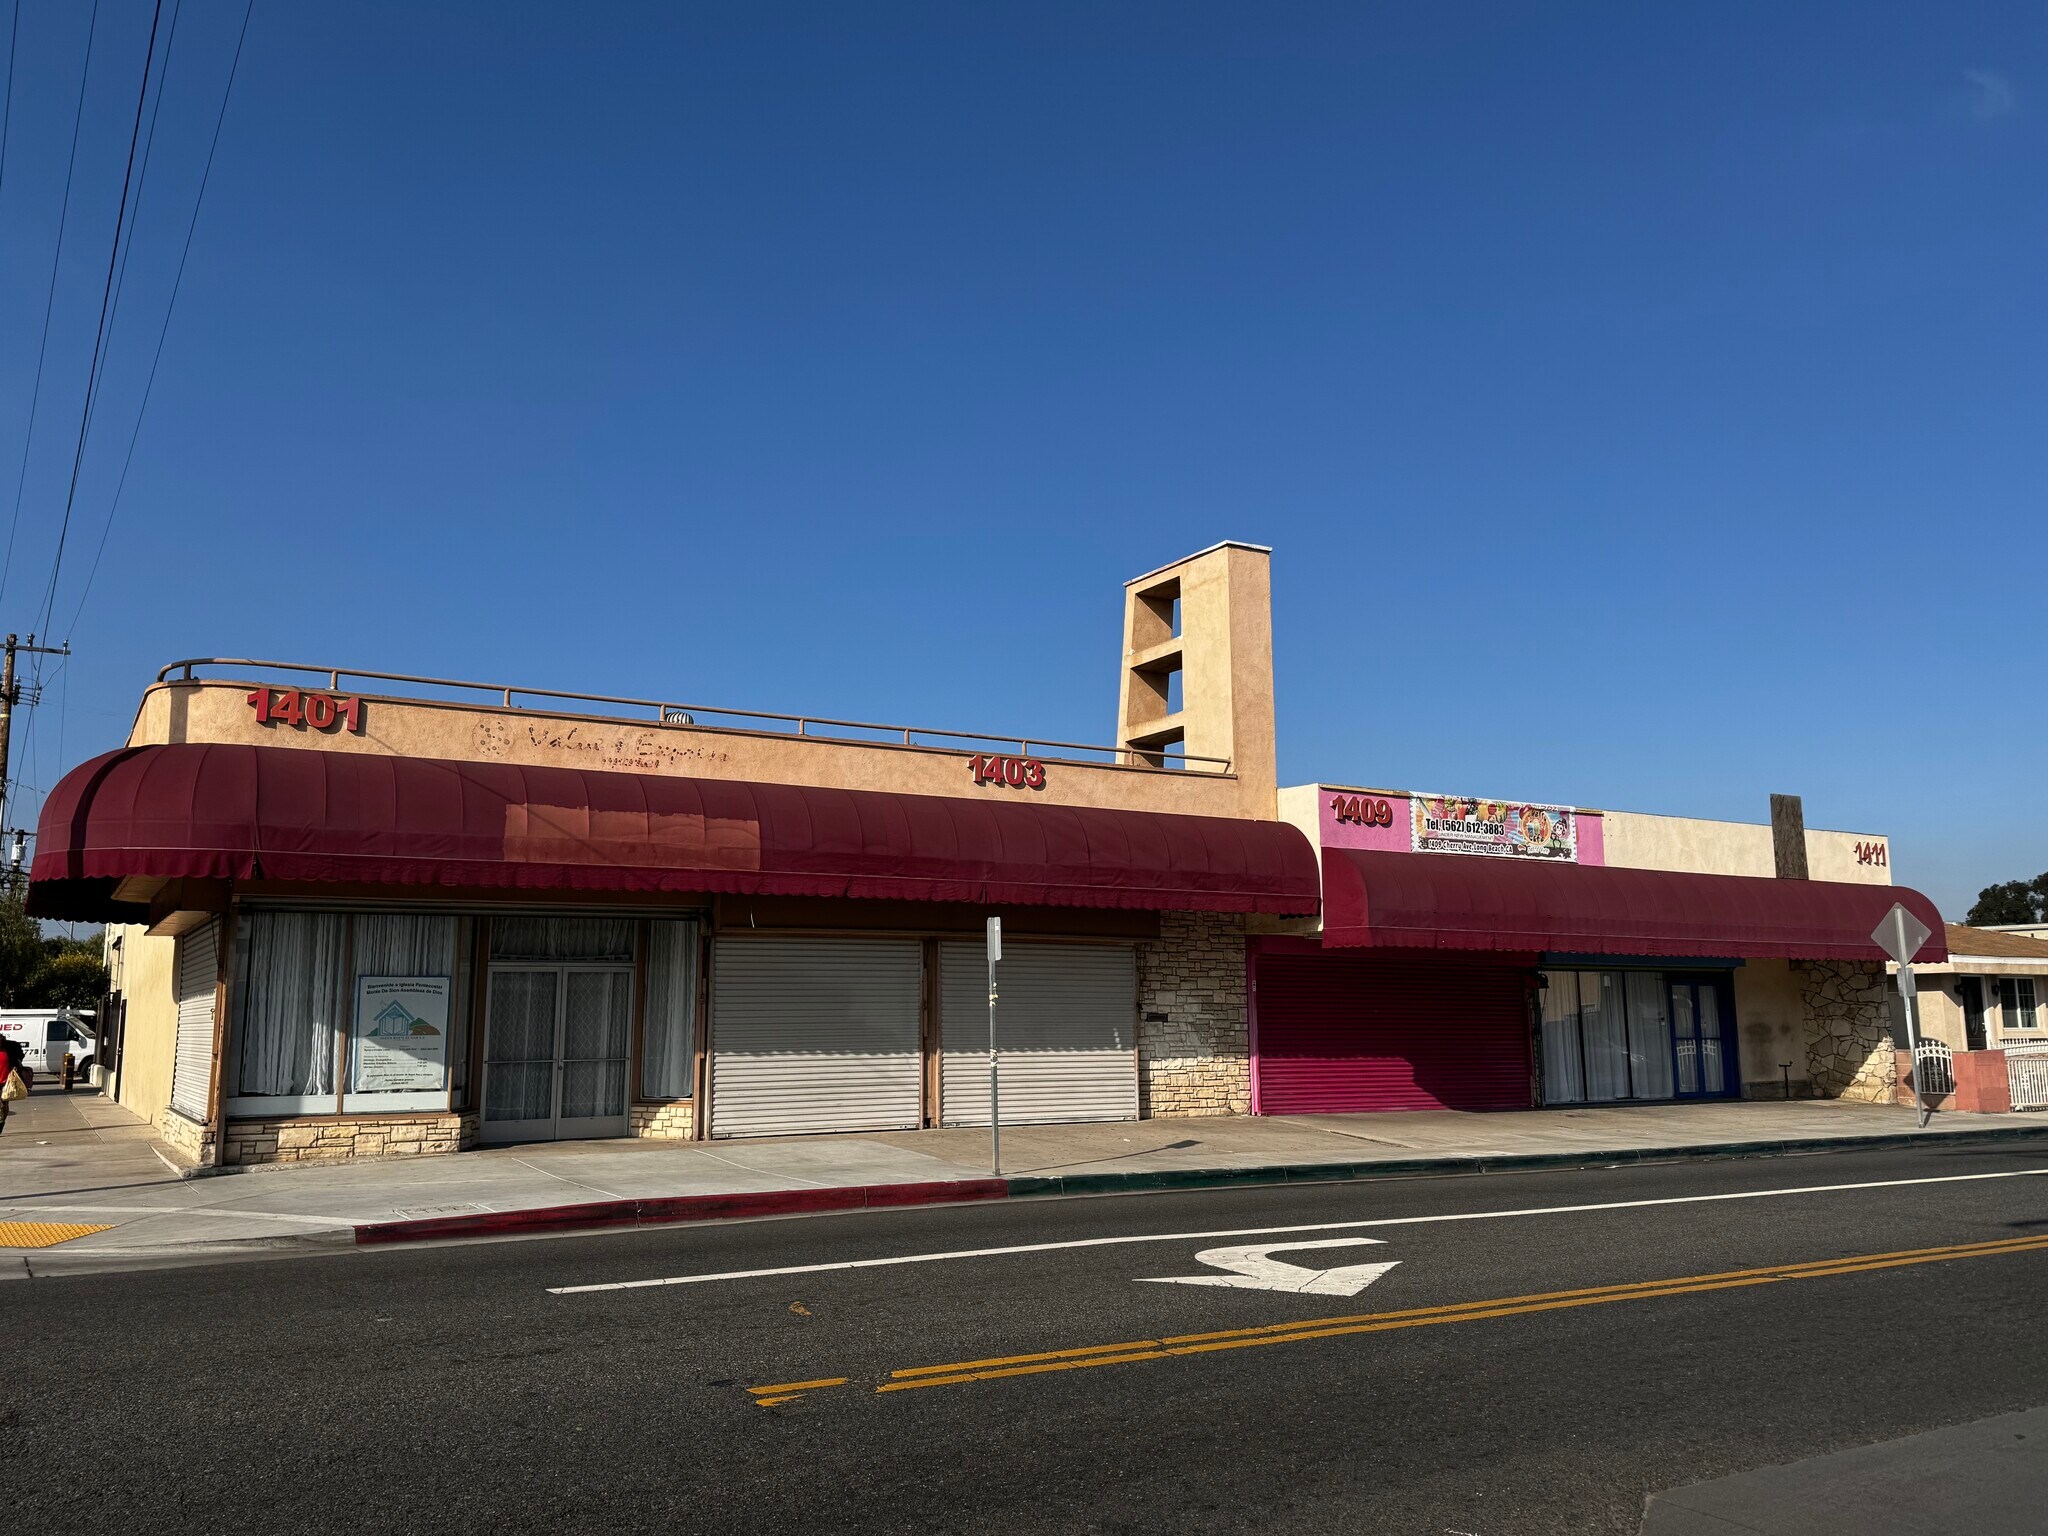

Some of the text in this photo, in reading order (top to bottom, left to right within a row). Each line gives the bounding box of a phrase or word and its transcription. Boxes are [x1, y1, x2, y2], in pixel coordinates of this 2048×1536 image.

[247, 688, 360, 731] 1401
[967, 755, 1044, 786] 1403
[1330, 795, 1391, 824] 1409
[1442, 819, 1464, 832] (562)
[1466, 821, 1504, 835] 612-3883
[1429, 840, 1441, 849] 1409
[1443, 841, 1461, 851] Cherry
[1854, 841, 1886, 866] 1411
